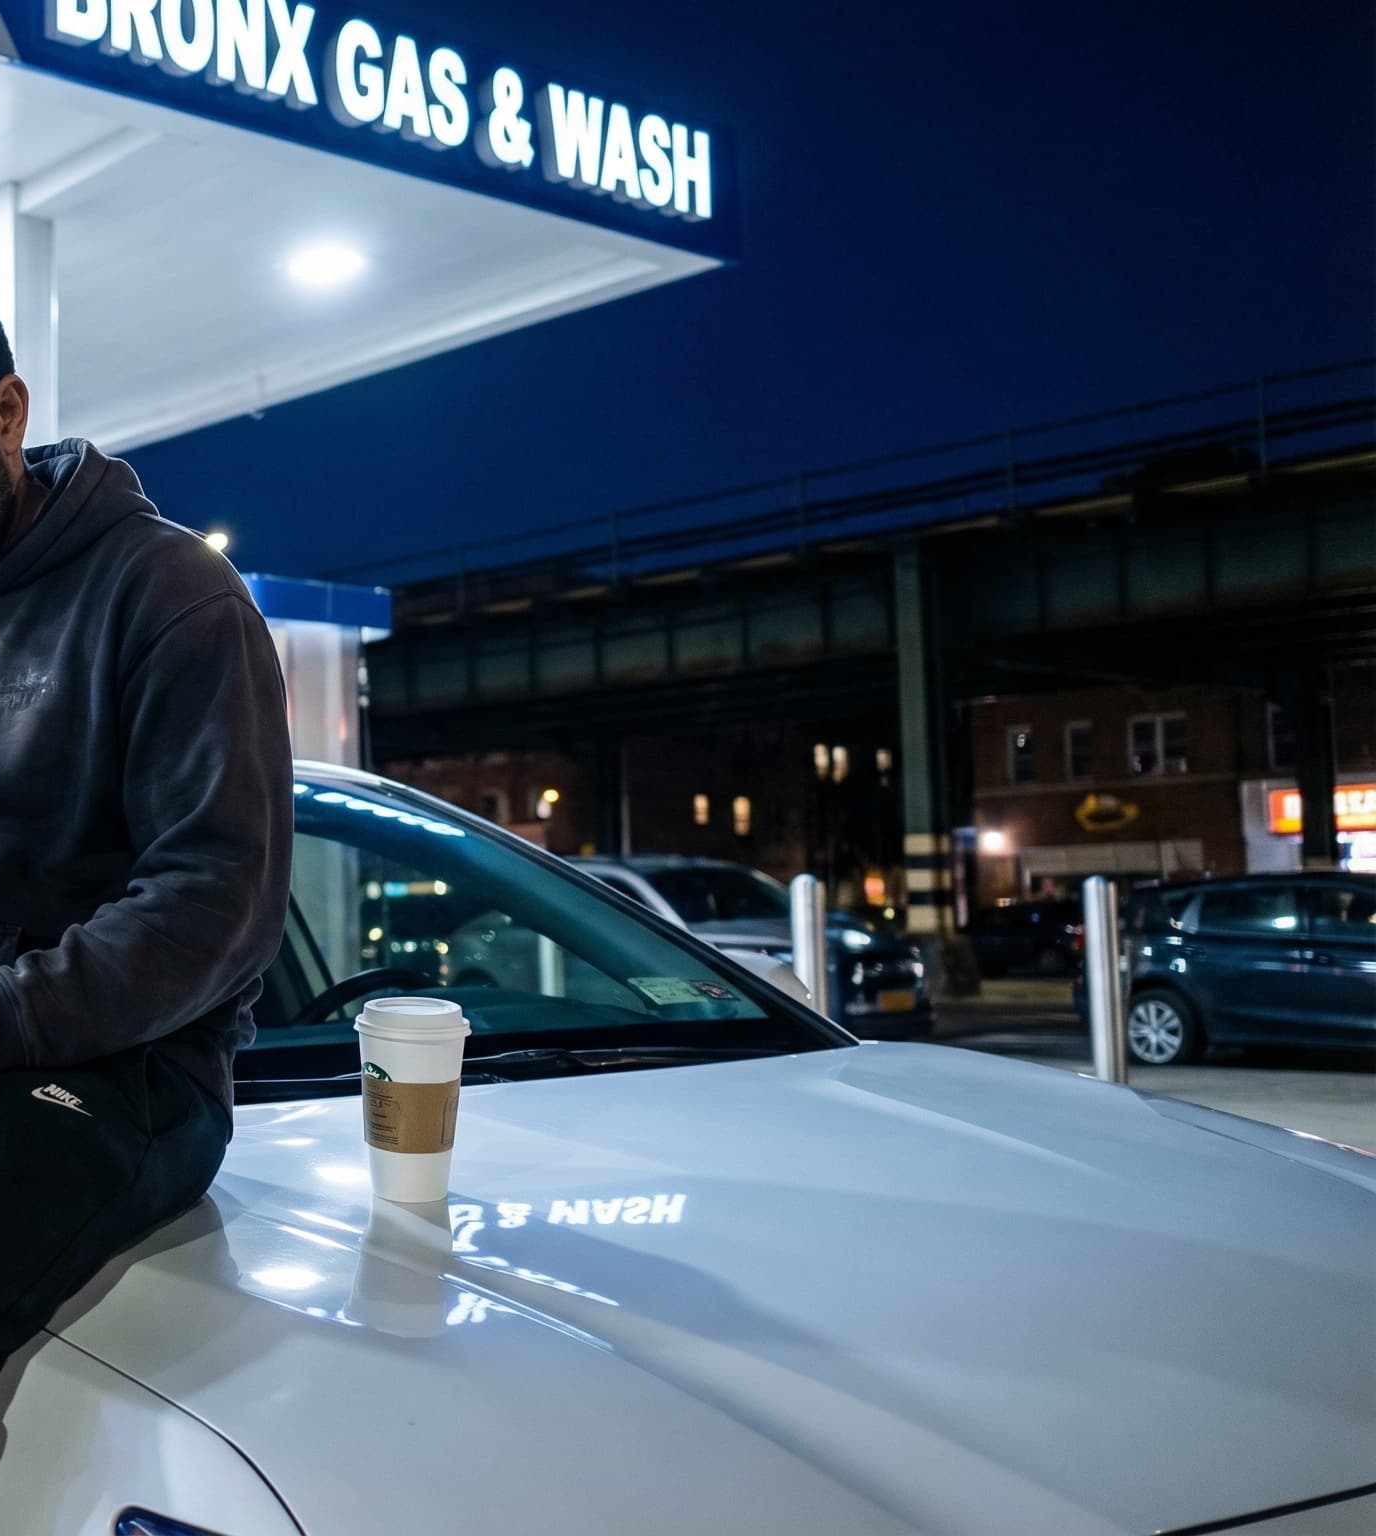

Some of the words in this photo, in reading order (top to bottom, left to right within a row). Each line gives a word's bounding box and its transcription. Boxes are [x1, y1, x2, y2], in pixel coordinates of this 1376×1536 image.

[335, 18, 470, 147] GAS
[487, 66, 535, 168] &
[547, 82, 712, 218] WASH
[43, 1083, 83, 1105] NIKE
